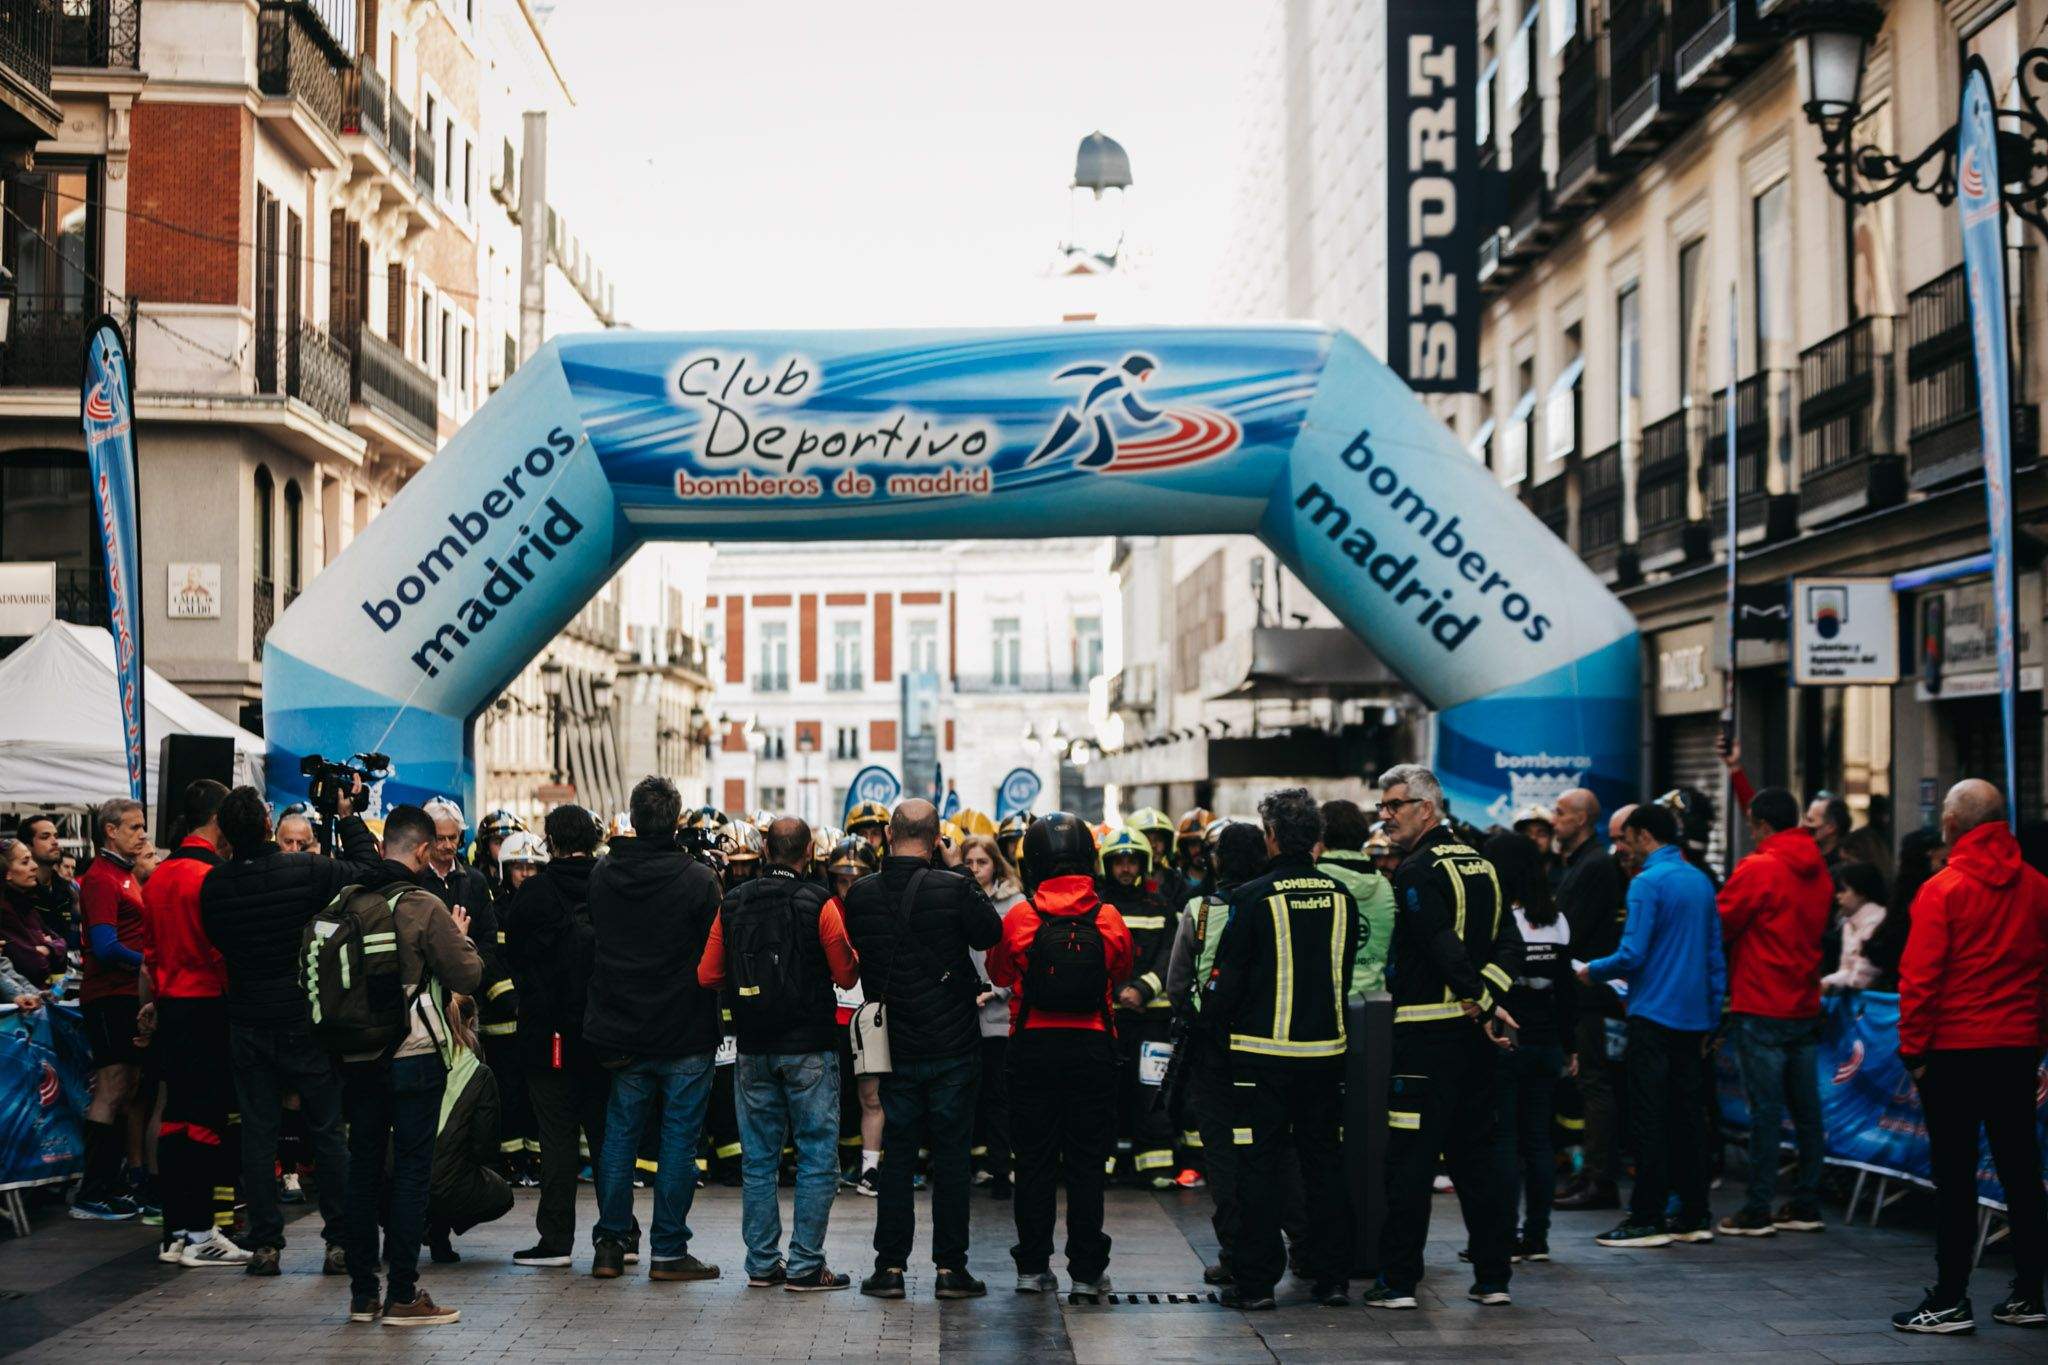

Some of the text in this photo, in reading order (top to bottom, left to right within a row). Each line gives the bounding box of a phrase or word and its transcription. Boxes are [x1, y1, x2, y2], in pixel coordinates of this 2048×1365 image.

[1408, 34, 1457, 380] SPORT
[679, 357, 809, 399] Club
[705, 398, 987, 473] Deportivo
[679, 469, 989, 496] bomberos de madrid
[361, 426, 575, 633] bomberos
[1295, 482, 1481, 651] madrid
[1340, 429, 1552, 642] bomberos
[0, 593, 50, 605] DIVARIUS
[411, 496, 584, 679] madrid
[1273, 878, 1335, 891] BOMBEROS
[1290, 896, 1331, 909] madrid
